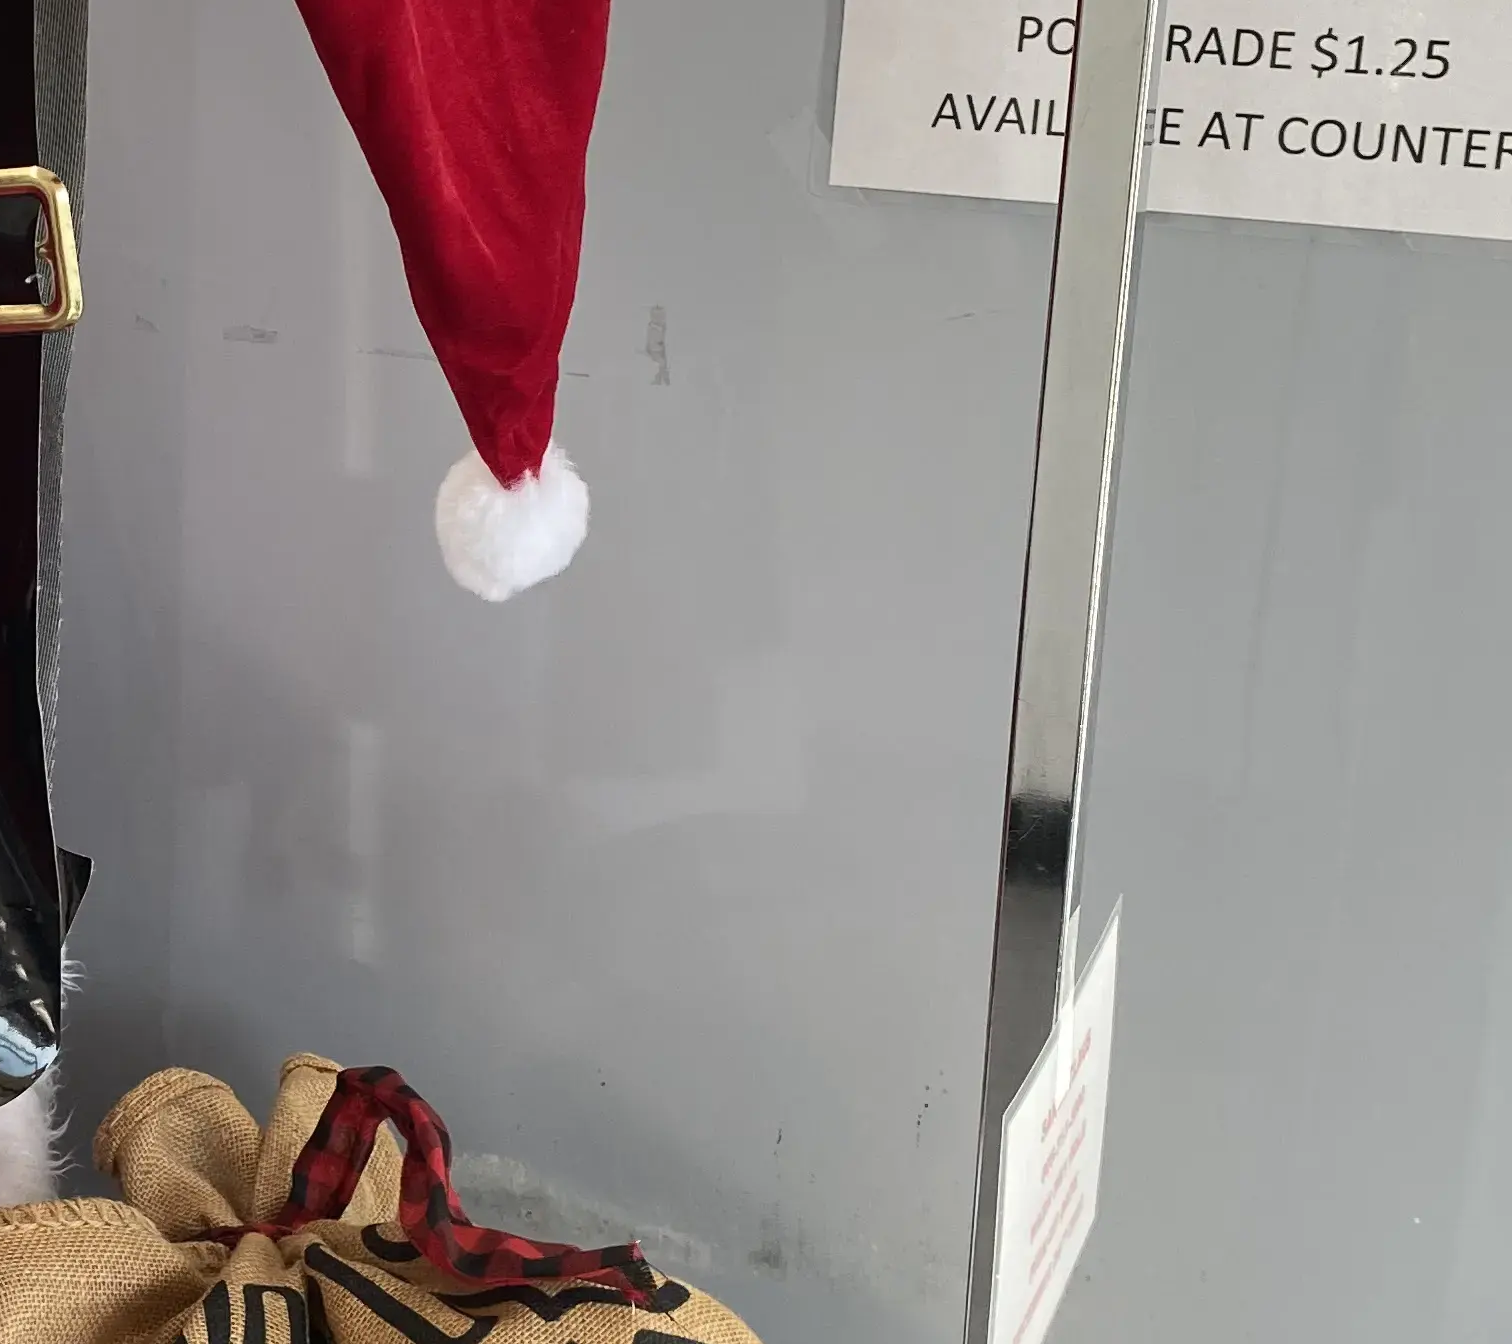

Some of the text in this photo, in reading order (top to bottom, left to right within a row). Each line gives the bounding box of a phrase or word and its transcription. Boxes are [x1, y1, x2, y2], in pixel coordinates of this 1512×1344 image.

[1017, 16, 1450, 78] PORADE $1.25
[931, 93, 1184, 145] AVAILE
[1198, 111, 1264, 151] AT
